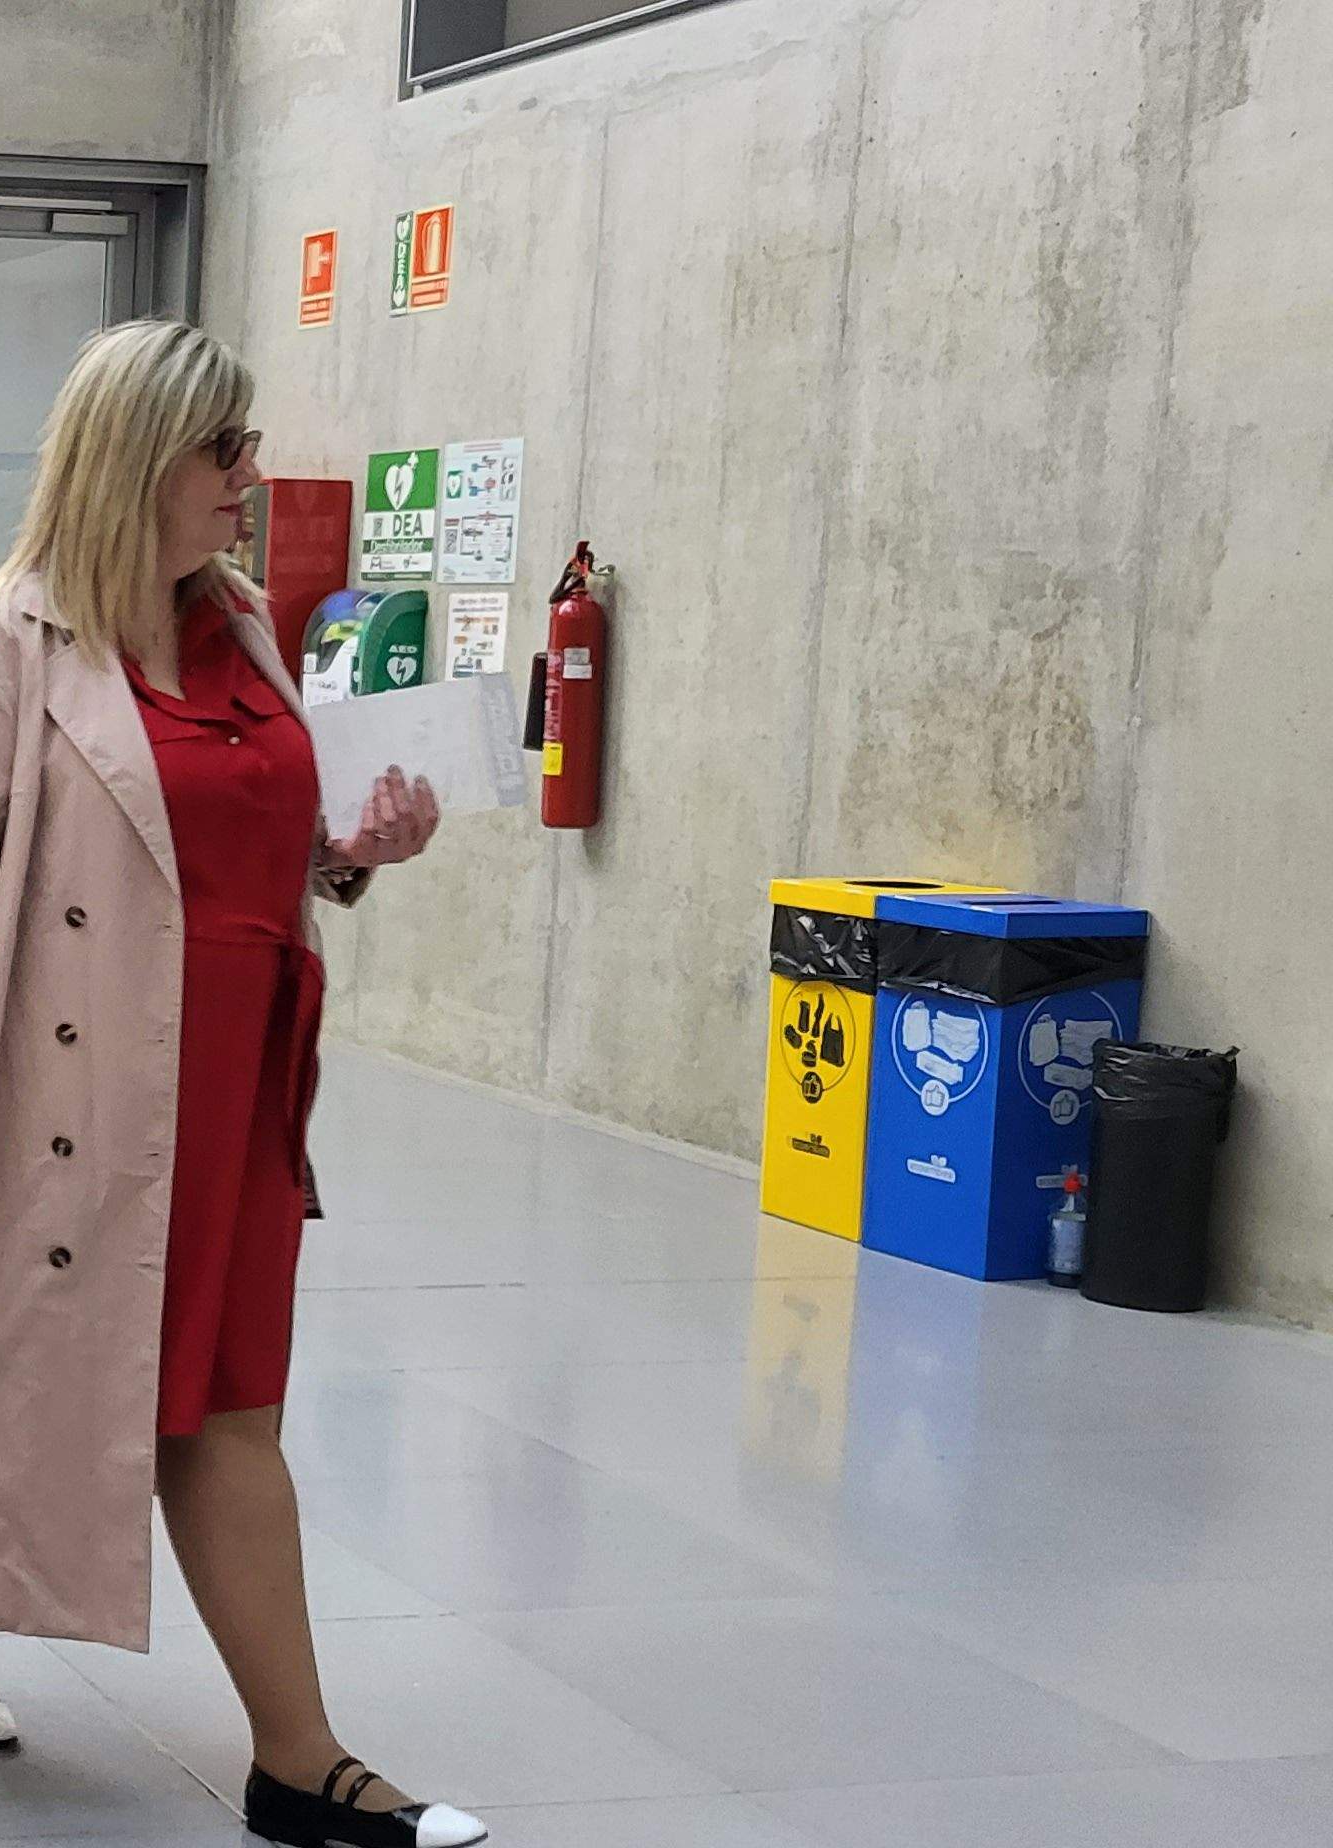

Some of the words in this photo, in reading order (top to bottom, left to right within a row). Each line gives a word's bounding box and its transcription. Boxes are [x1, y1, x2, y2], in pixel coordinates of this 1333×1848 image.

[395, 241, 407, 291] DEA
[393, 512, 422, 537] DEA
[388, 644, 418, 654] AED
